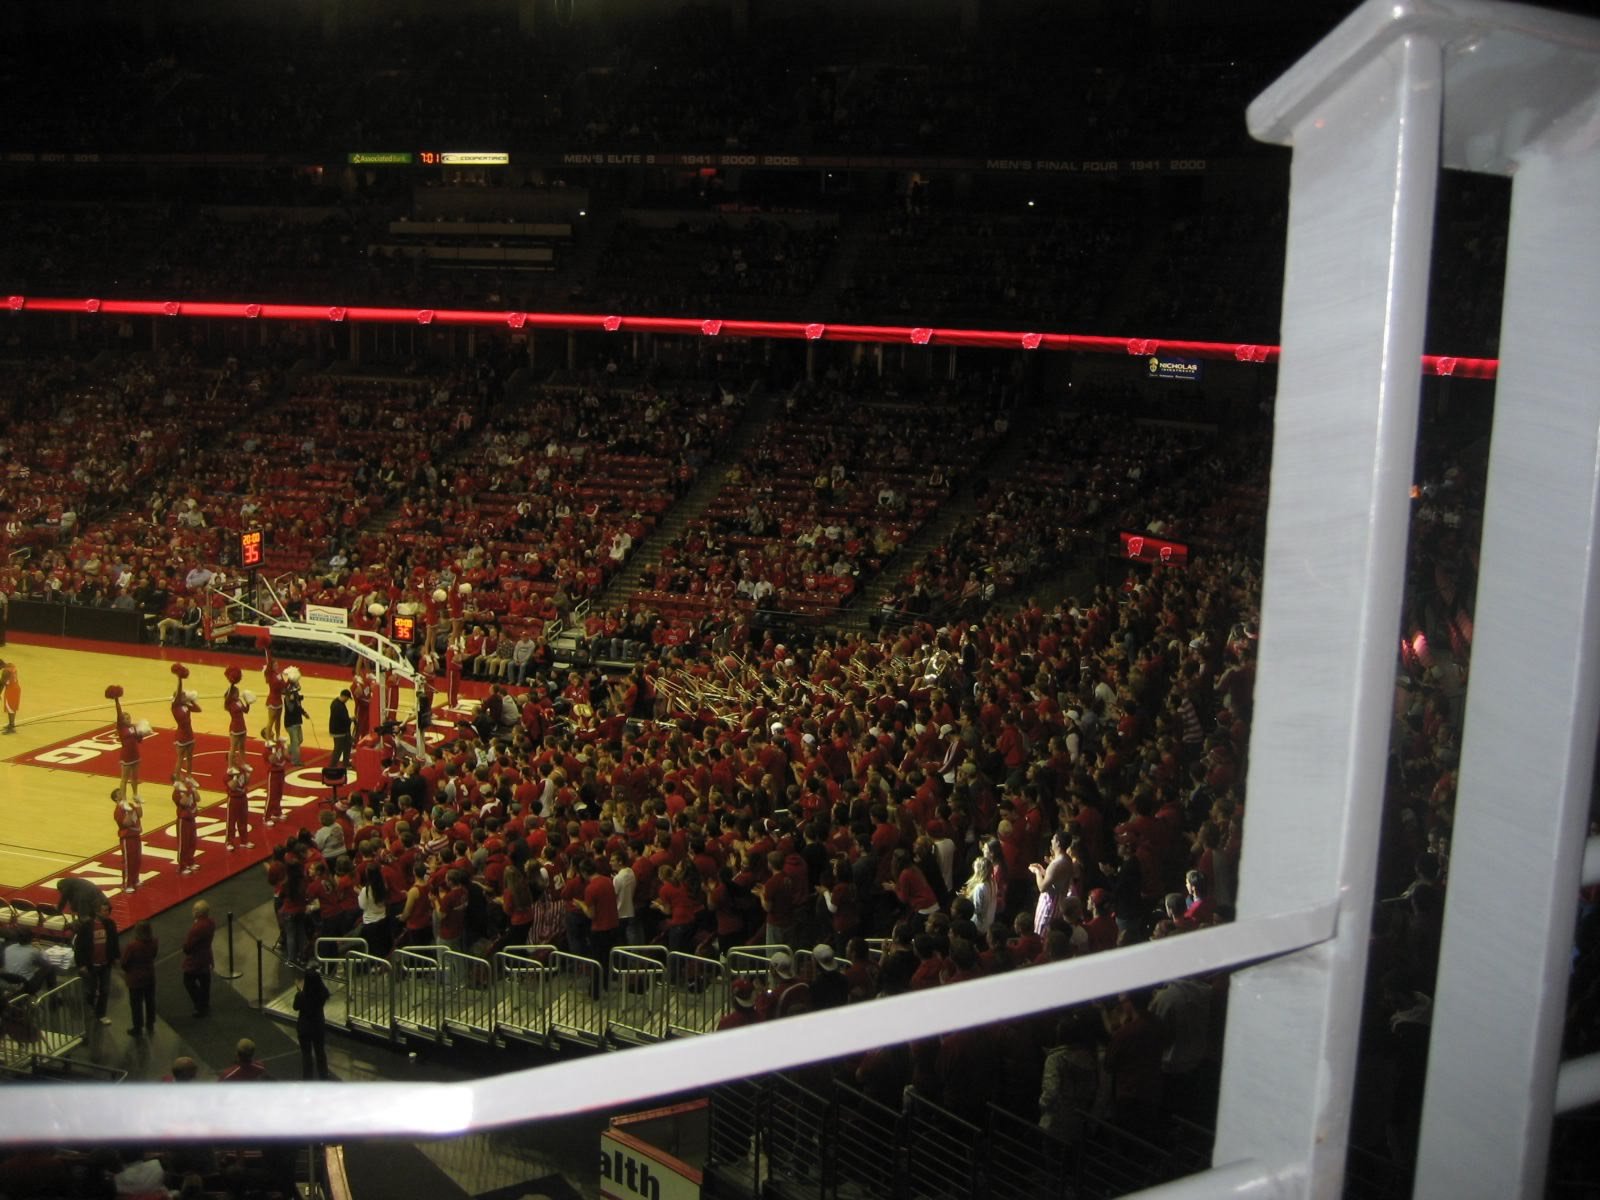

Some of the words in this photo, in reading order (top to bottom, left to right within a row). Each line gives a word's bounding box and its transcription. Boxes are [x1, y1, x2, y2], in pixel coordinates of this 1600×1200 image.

[420, 152, 440, 164] 7:01
[564, 154, 602, 165] MEN'S
[607, 154, 641, 165] ELITE
[646, 154, 656, 165] 8
[680, 154, 712, 166] 1941
[720, 155, 757, 166] 2000
[764, 156, 800, 166] 2005
[986, 159, 1032, 170] MEN'S
[1036, 160, 1078, 171] FINAL
[1082, 161, 1119, 172] FOUR
[1129, 160, 1160, 171] 1941
[1170, 159, 1206, 170] 2000
[1159, 363, 1197, 371] NICHOLAS
[242, 532, 261, 546] 20:00
[244, 543, 259, 563] 35
[394, 617, 413, 628] 20:00
[397, 626, 410, 639] 35
